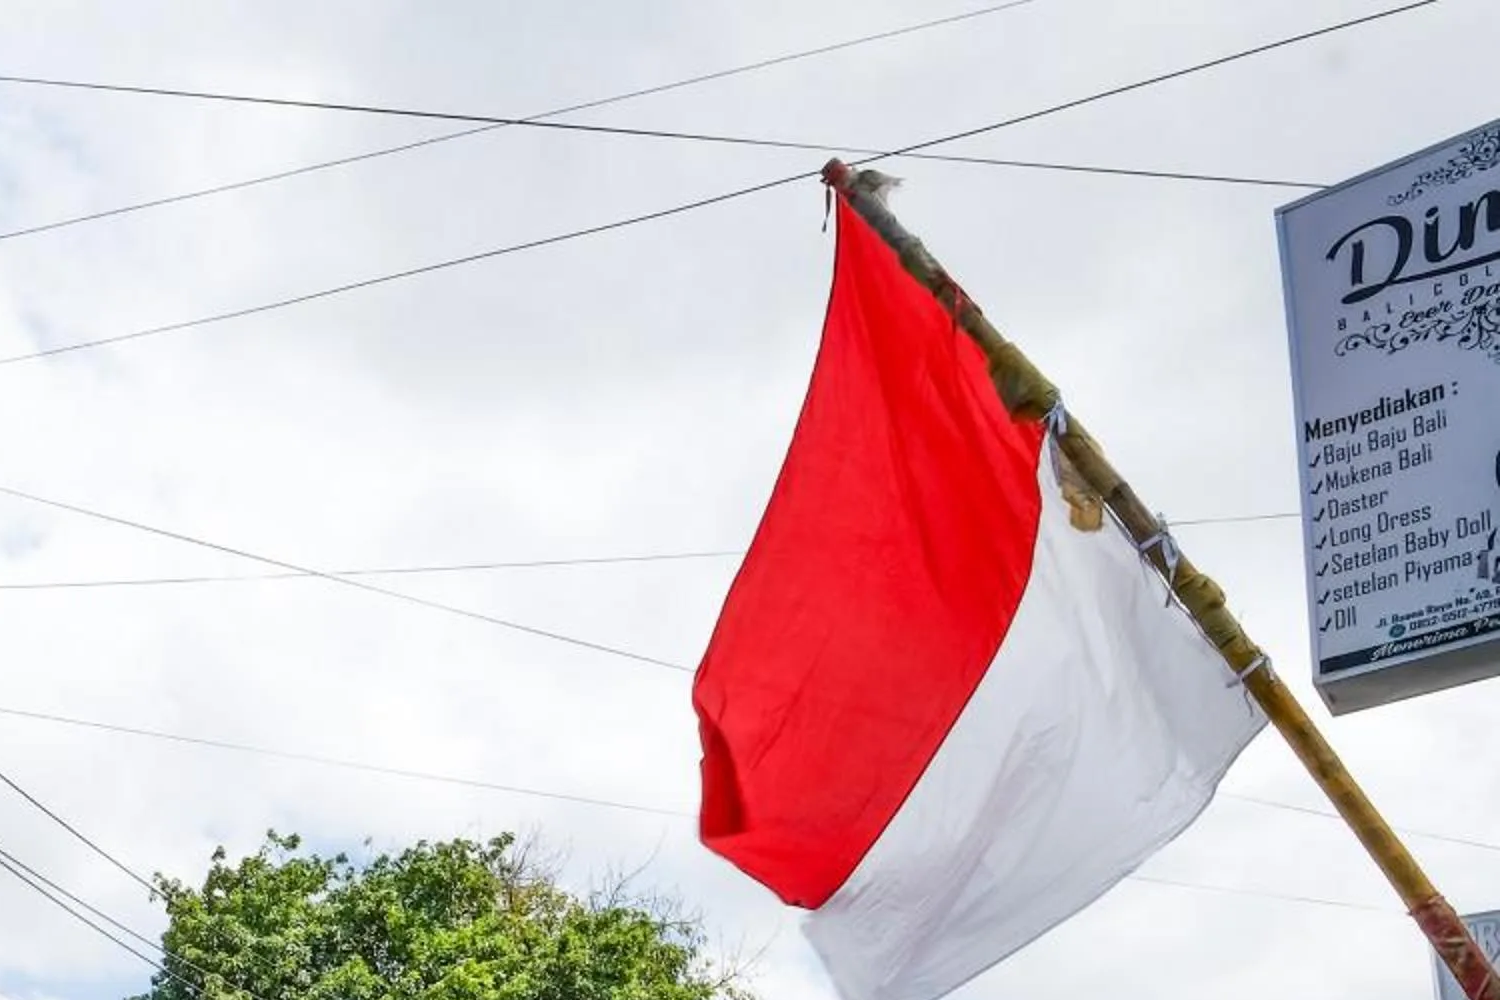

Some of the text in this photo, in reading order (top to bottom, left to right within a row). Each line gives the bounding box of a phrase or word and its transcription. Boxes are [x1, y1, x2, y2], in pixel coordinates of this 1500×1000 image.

[1305, 385, 1446, 442] Menyediakan
[1323, 408, 1447, 465] Baju Baju Bali
[1326, 443, 1432, 492] Mukena Bali
[1328, 491, 1389, 520] Daster
[1330, 505, 1432, 547] Long Dress
[1331, 508, 1491, 575] Setelan Baby Doll
[1333, 550, 1473, 602] setelan Piyama
